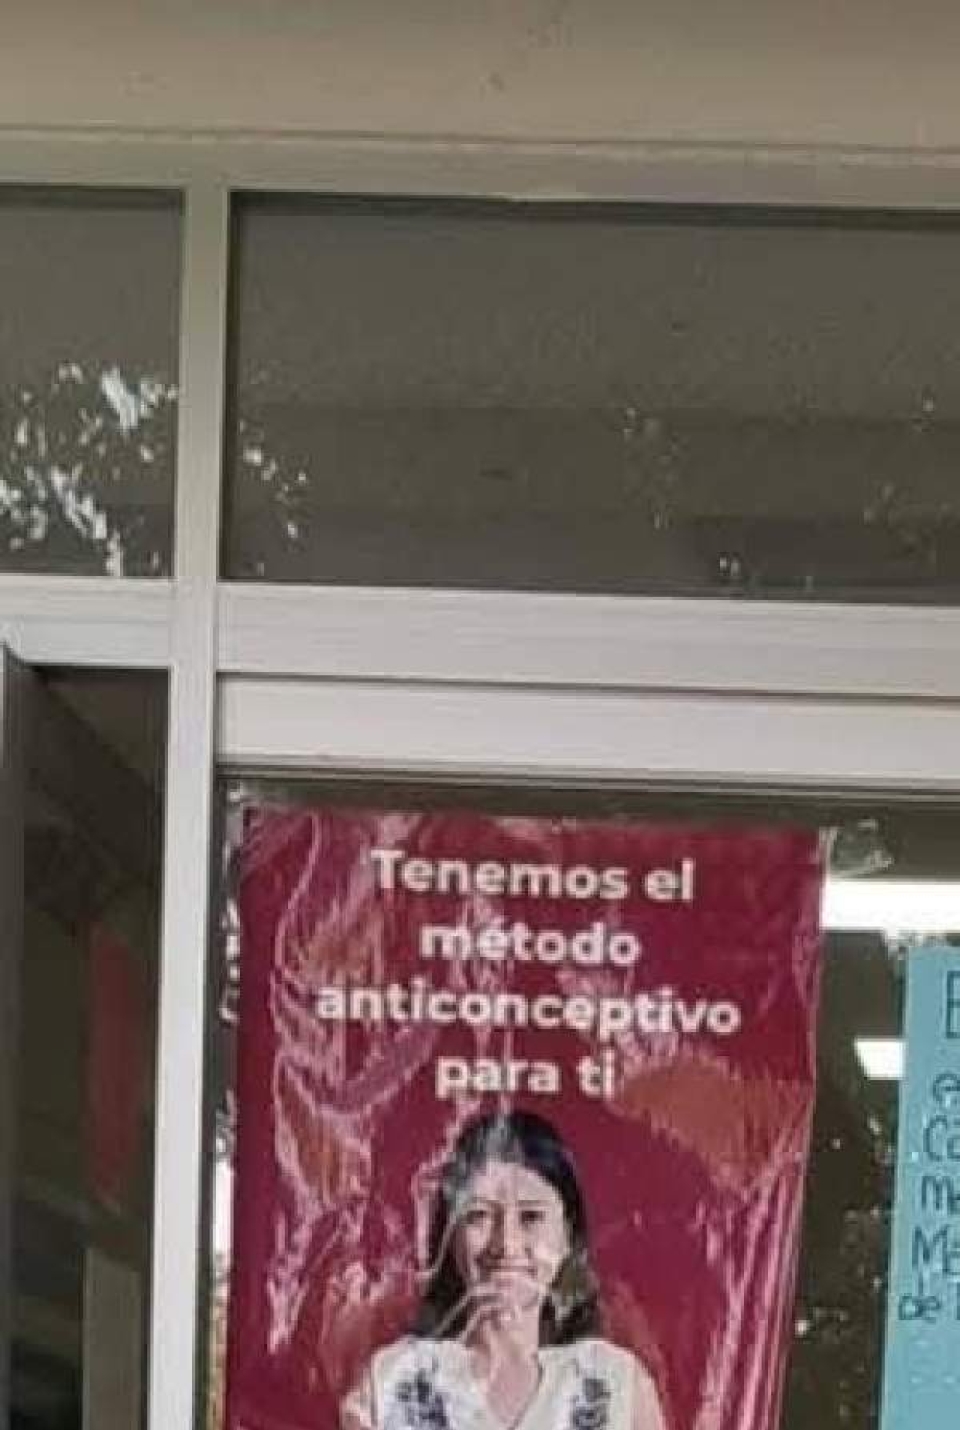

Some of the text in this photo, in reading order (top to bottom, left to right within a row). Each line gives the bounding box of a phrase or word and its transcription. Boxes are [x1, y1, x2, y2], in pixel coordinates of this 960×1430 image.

[370, 849, 694, 901] Tenemos el
[420, 921, 641, 964] método
[316, 979, 741, 1035] anticonceptivo
[436, 1050, 615, 1099] para ti
